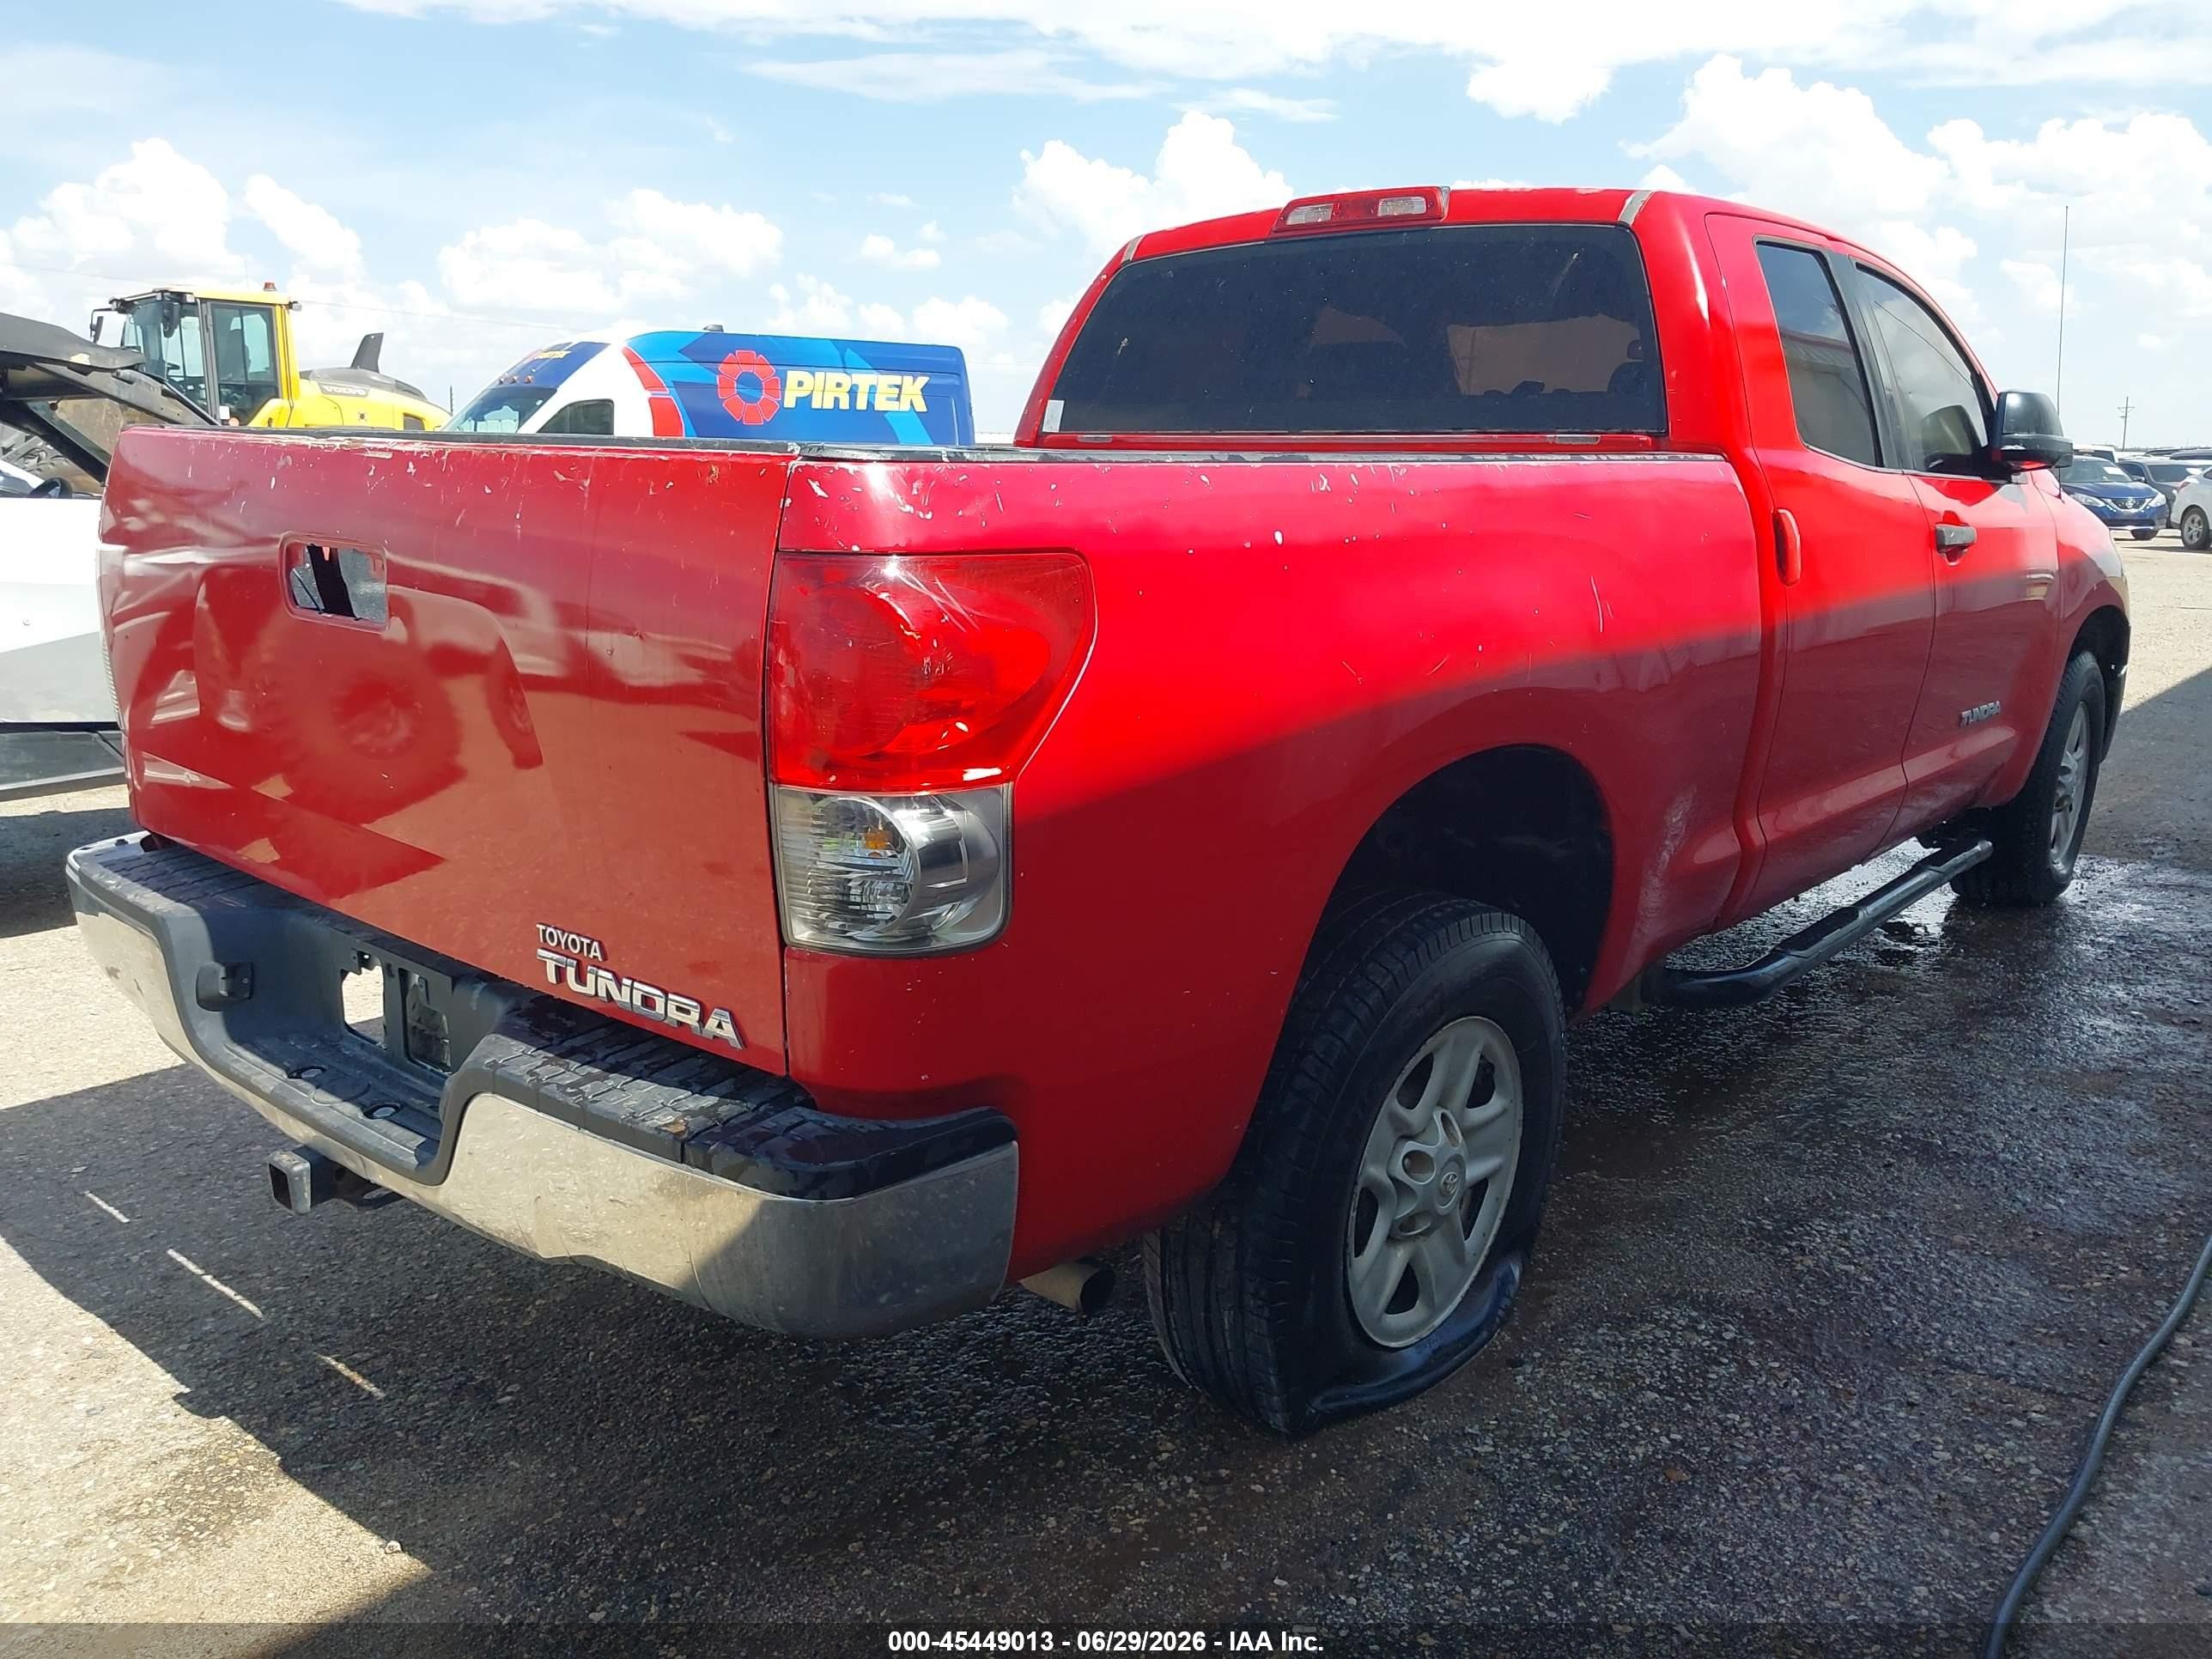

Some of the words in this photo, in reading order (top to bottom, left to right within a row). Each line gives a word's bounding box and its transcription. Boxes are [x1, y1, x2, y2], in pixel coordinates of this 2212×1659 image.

[322, 385, 366, 396] VOLVO
[783, 370, 930, 412] PIRTEK
[1960, 701, 2002, 727] TUNDRA
[536, 923, 605, 962] TOYOTA
[536, 948, 745, 1050] TUNDRA
